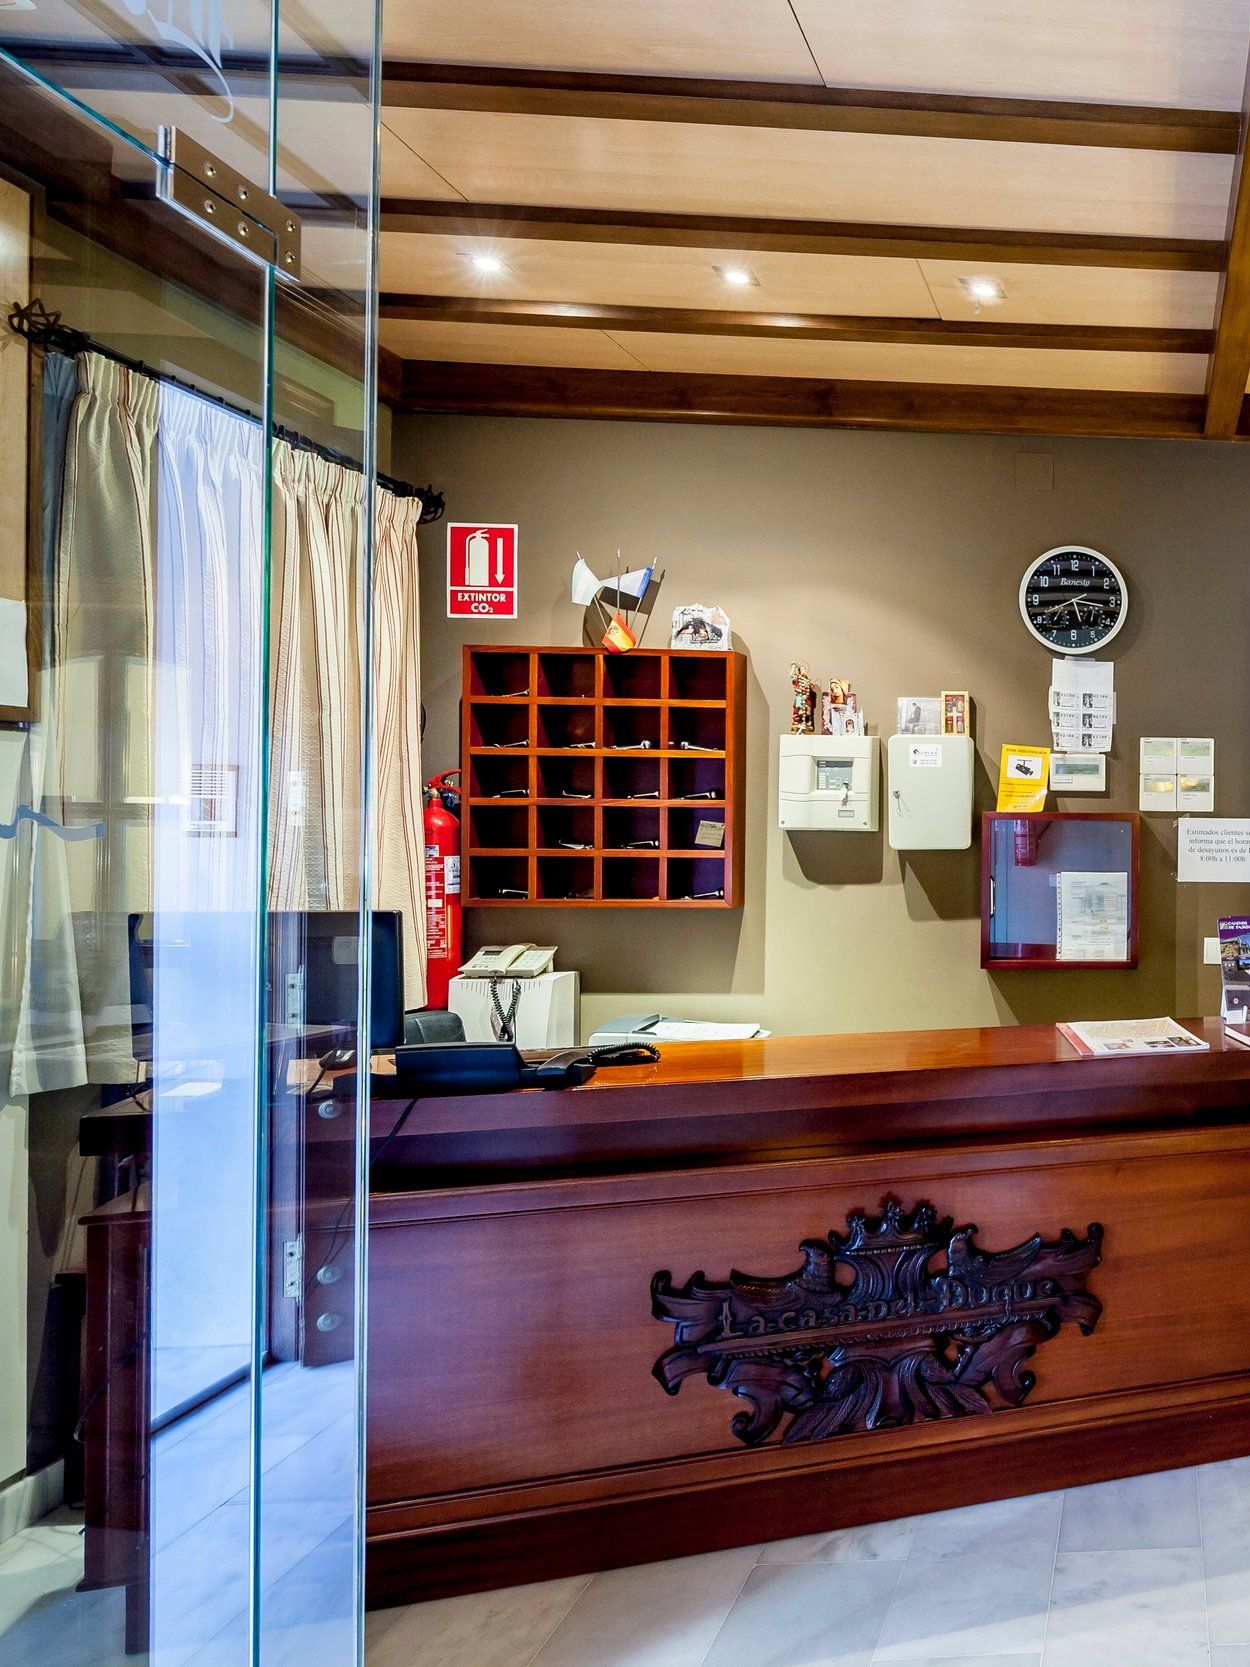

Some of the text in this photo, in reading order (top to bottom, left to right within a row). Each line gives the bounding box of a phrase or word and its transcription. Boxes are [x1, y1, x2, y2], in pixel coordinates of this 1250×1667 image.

[1053, 565, 1060, 575] 11
[1070, 560, 1079, 571] 12
[1040, 576, 1049, 587] 10
[1060, 577, 1091, 587] Banesto
[457, 592, 506, 602] EXTINTOR
